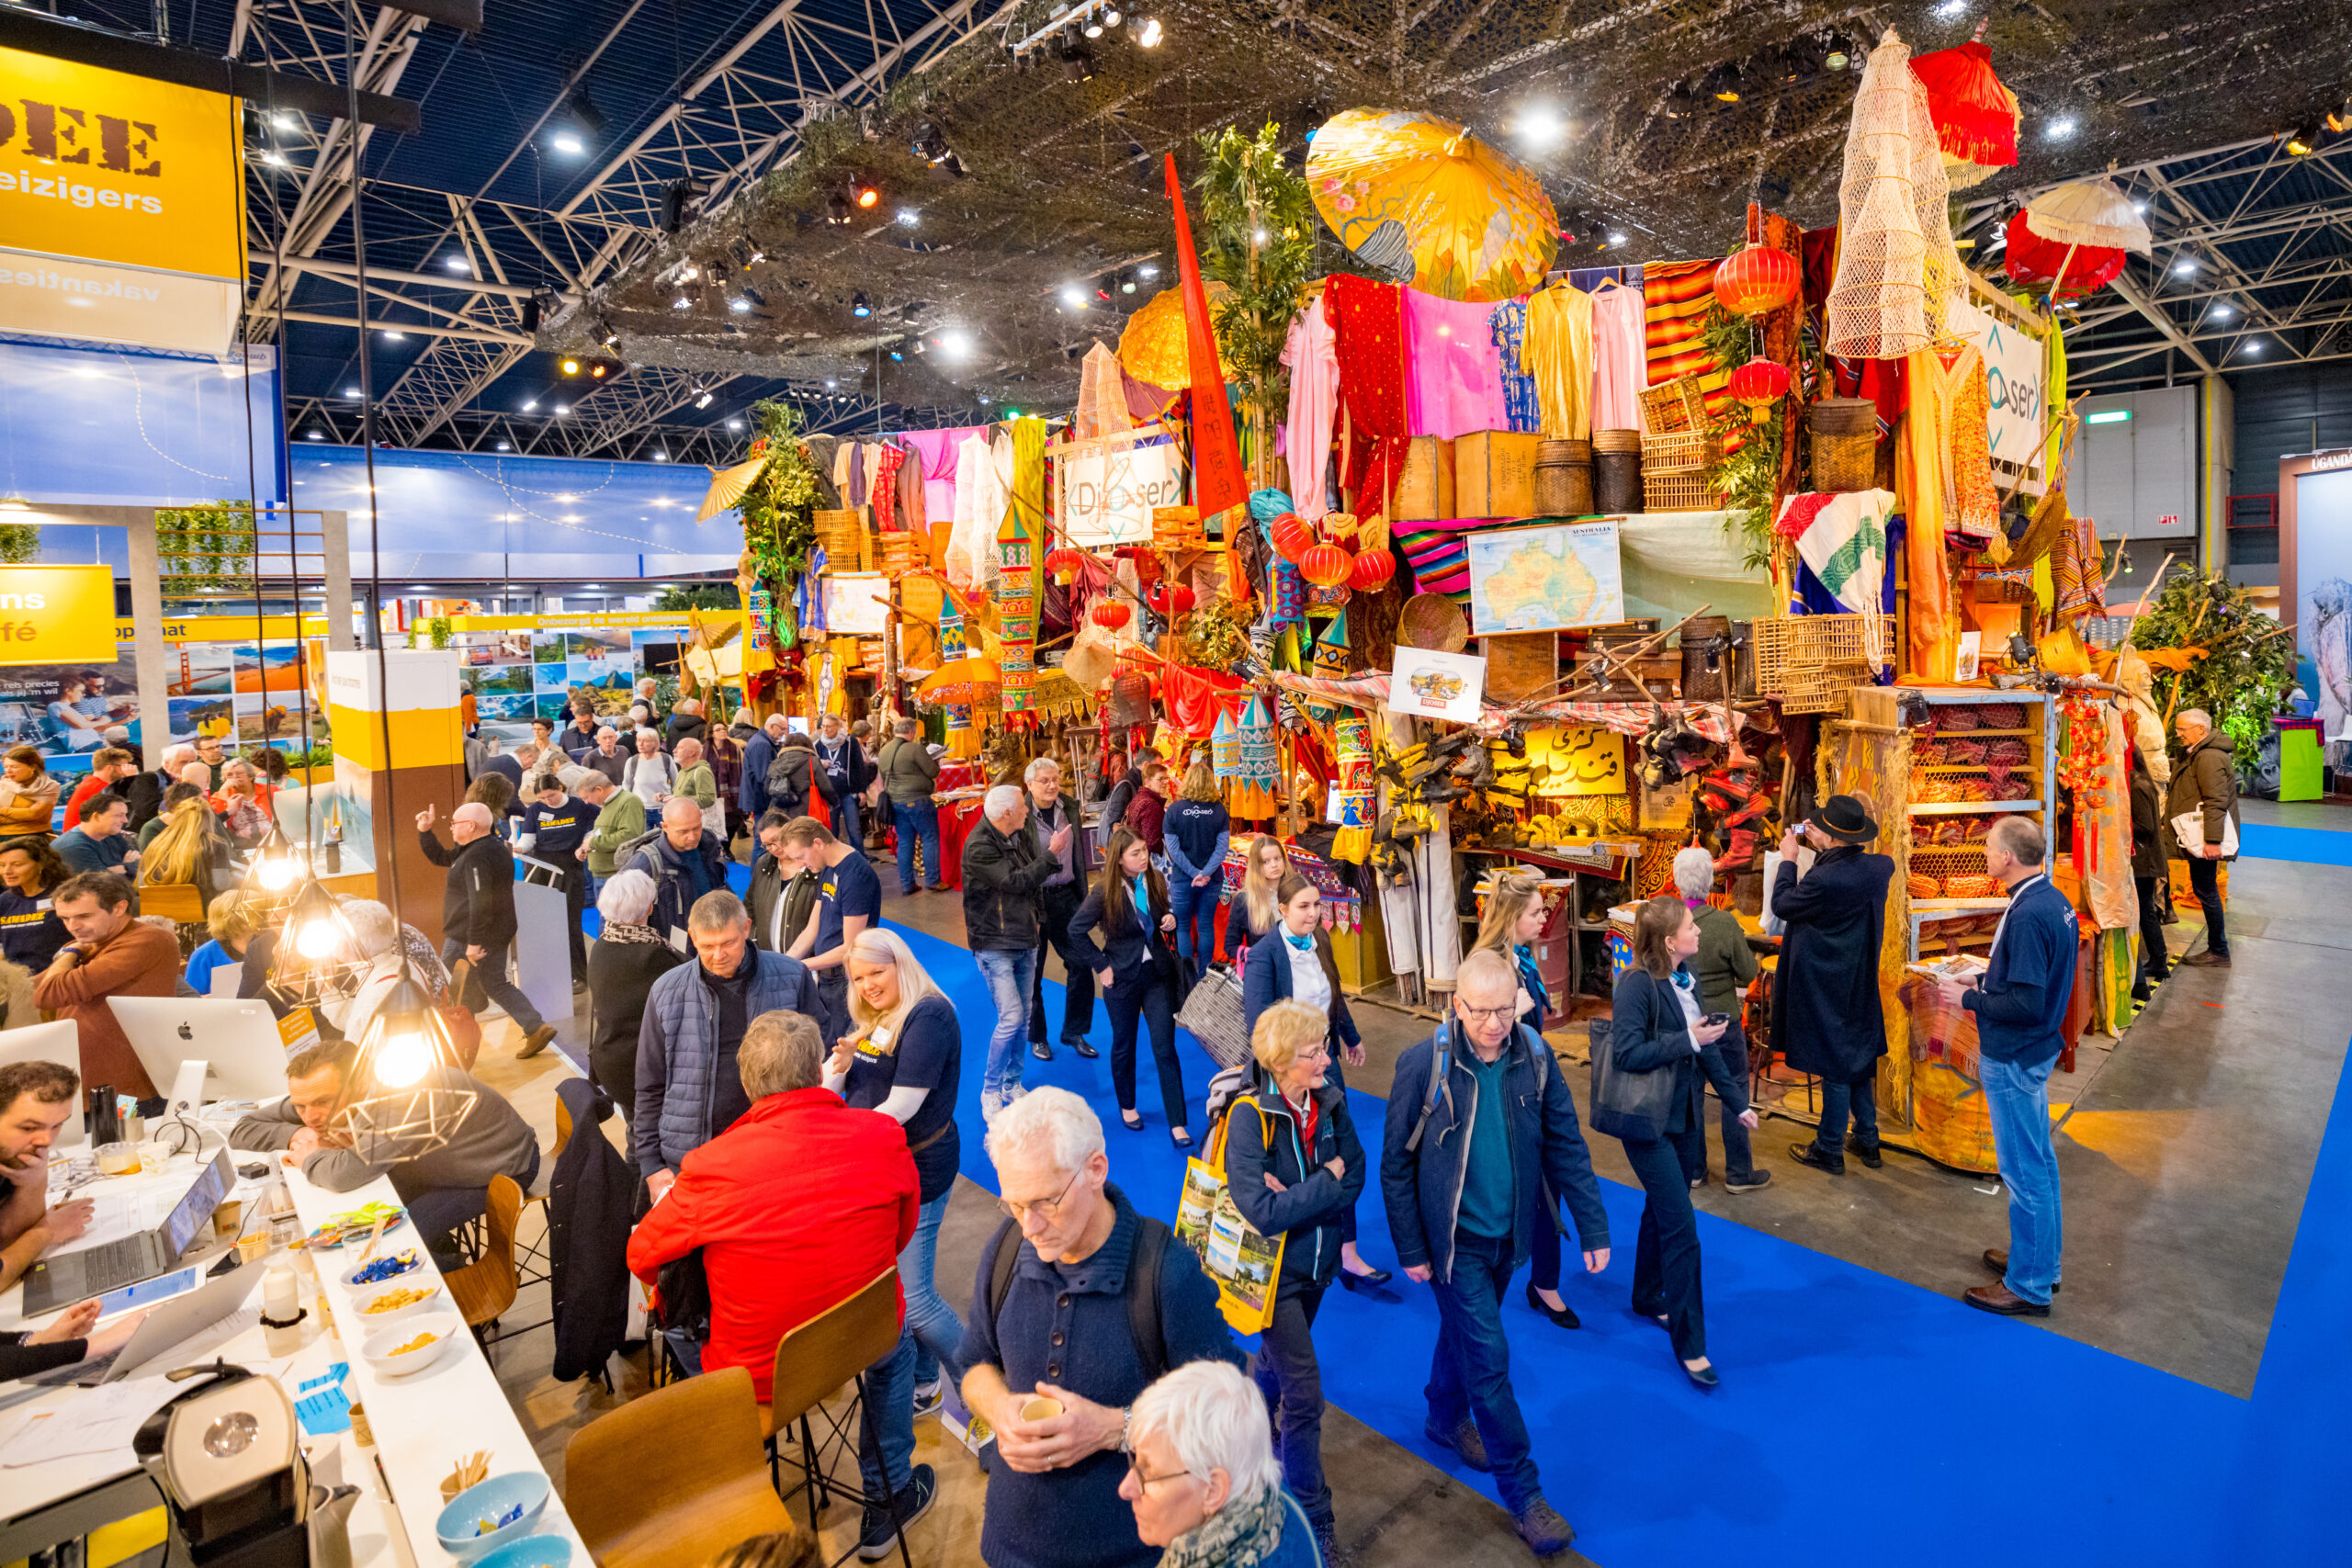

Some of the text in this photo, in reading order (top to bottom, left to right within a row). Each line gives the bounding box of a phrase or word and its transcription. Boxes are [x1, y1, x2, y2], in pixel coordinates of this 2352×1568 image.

[0, 98, 162, 177] EE
[0, 169, 164, 214] eizigers
[1573, 526, 1611, 535] AUSTRALIA
[537, 615, 689, 626] Onbezorgd de wereld ontdekken
[25, 680, 60, 689] precies
